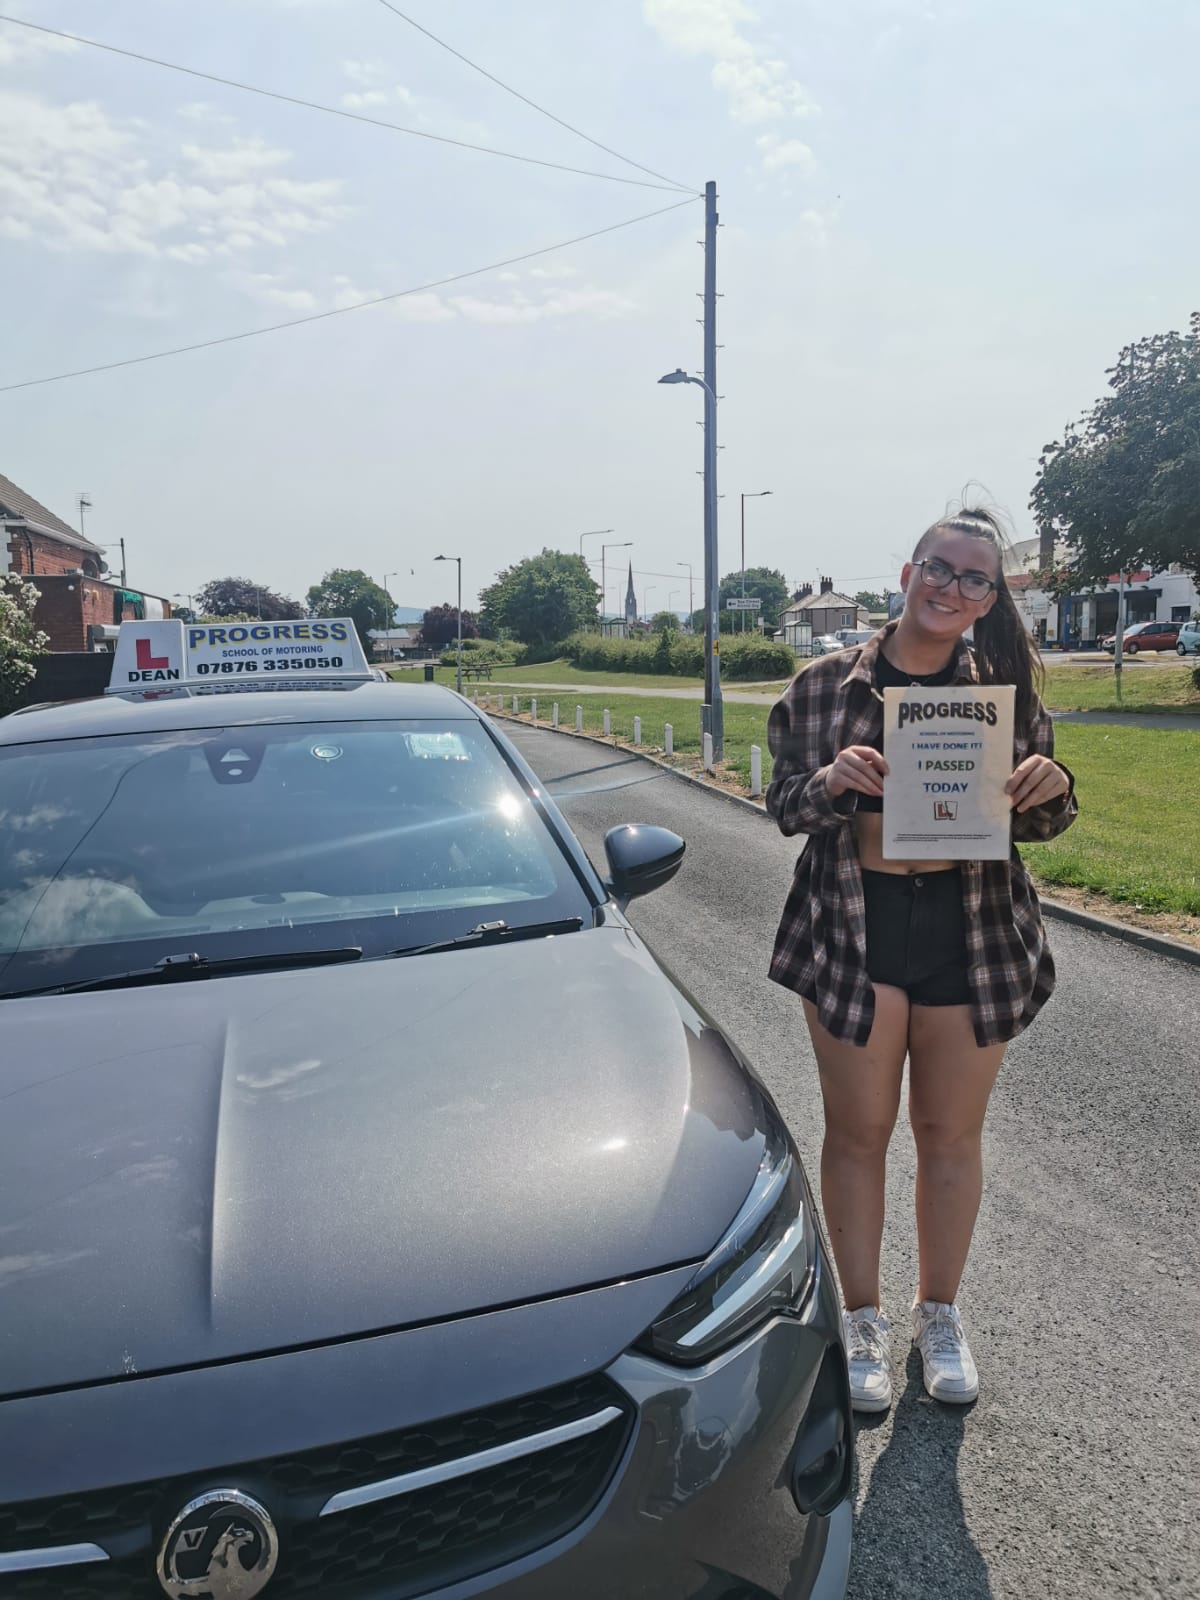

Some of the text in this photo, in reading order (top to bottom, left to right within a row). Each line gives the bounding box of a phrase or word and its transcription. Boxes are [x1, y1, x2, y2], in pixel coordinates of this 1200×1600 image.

[189, 622, 347, 649] PROGRESS
[136, 639, 169, 670] L
[222, 645, 323, 658] SCHOOL OF MOTORING
[197, 656, 343, 675] 07876 335050
[128, 668, 180, 682] DEAN
[898, 702, 997, 729] PROGRESS
[918, 760, 975, 771] I PASSED
[923, 782, 969, 793] TODAY
[184, 1531, 202, 1548] V
